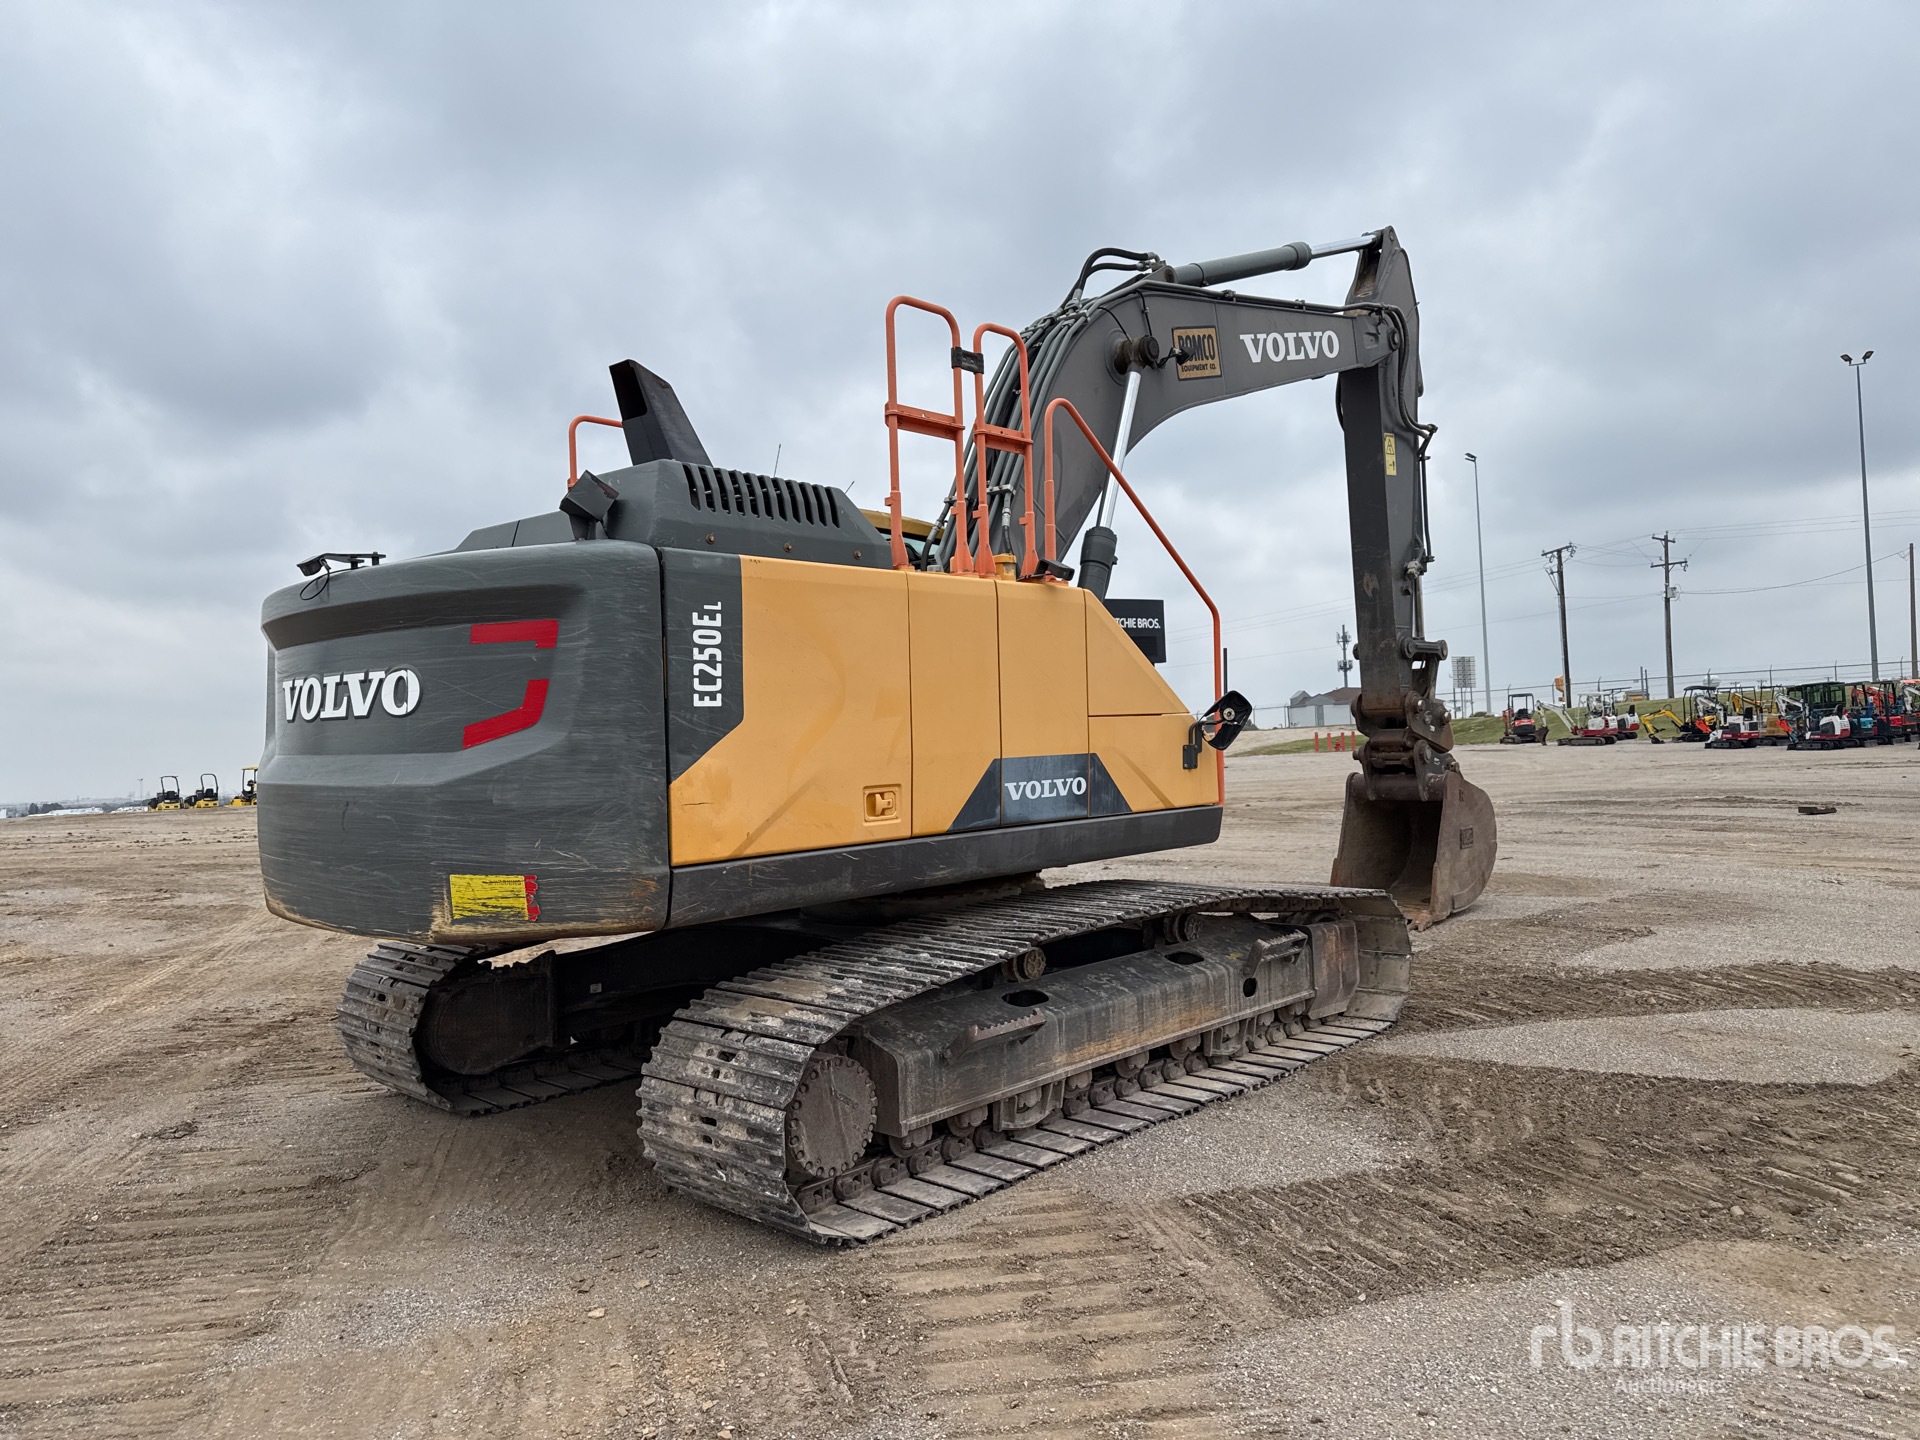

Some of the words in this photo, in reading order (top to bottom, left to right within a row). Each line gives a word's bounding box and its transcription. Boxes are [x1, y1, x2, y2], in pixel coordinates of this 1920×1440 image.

[1239, 330, 1339, 363] VOLVO
[1181, 363, 1208, 372] EQUIPMENT
[1113, 617, 1137, 628] TCHIE
[1137, 618, 1161, 629] BROS.
[692, 601, 722, 707] EC250EL
[282, 669, 420, 722] VOLVO
[1004, 776, 1087, 801] VOLVO
